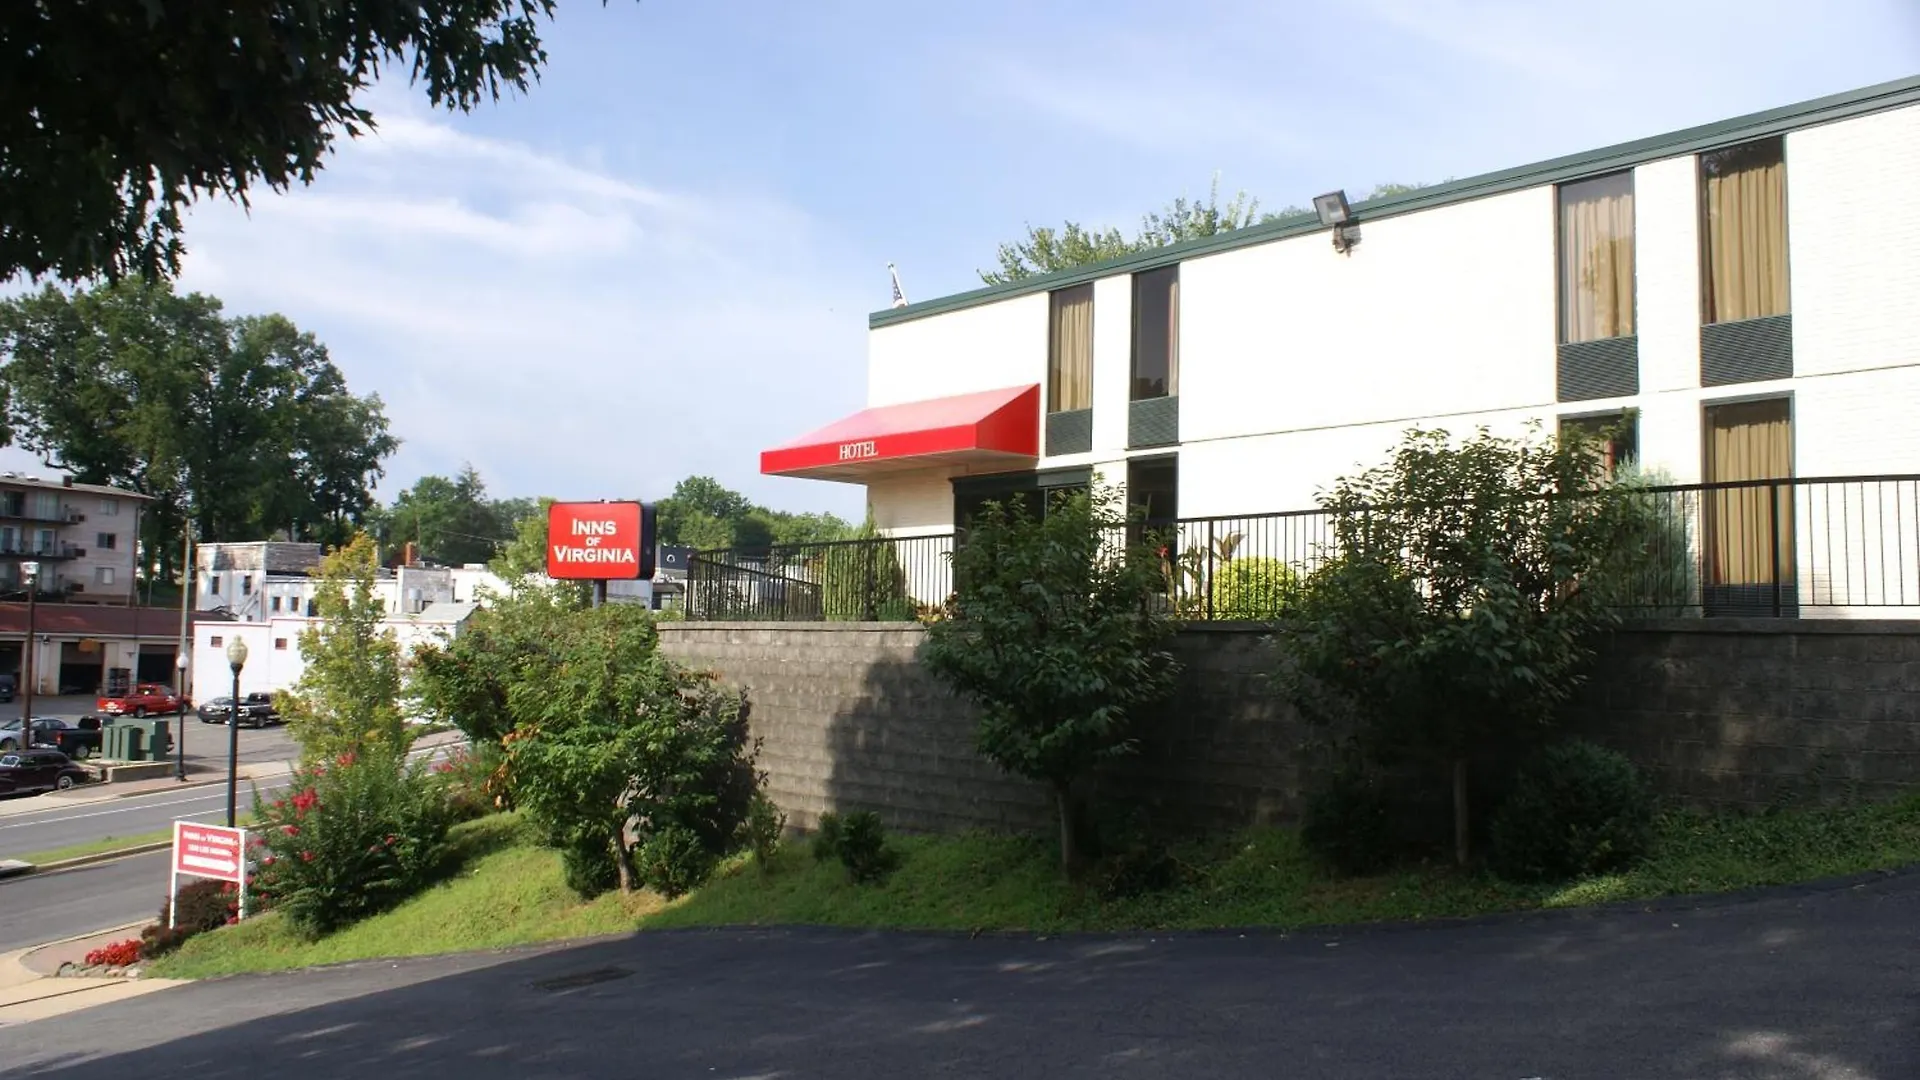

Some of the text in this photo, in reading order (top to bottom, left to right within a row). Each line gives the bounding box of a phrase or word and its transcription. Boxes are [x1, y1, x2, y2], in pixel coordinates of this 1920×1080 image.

[839, 441, 879, 460] HOTEL
[571, 518, 617, 535] INNS
[585, 537, 602, 547] OF
[553, 545, 636, 563] VIRGINIA
